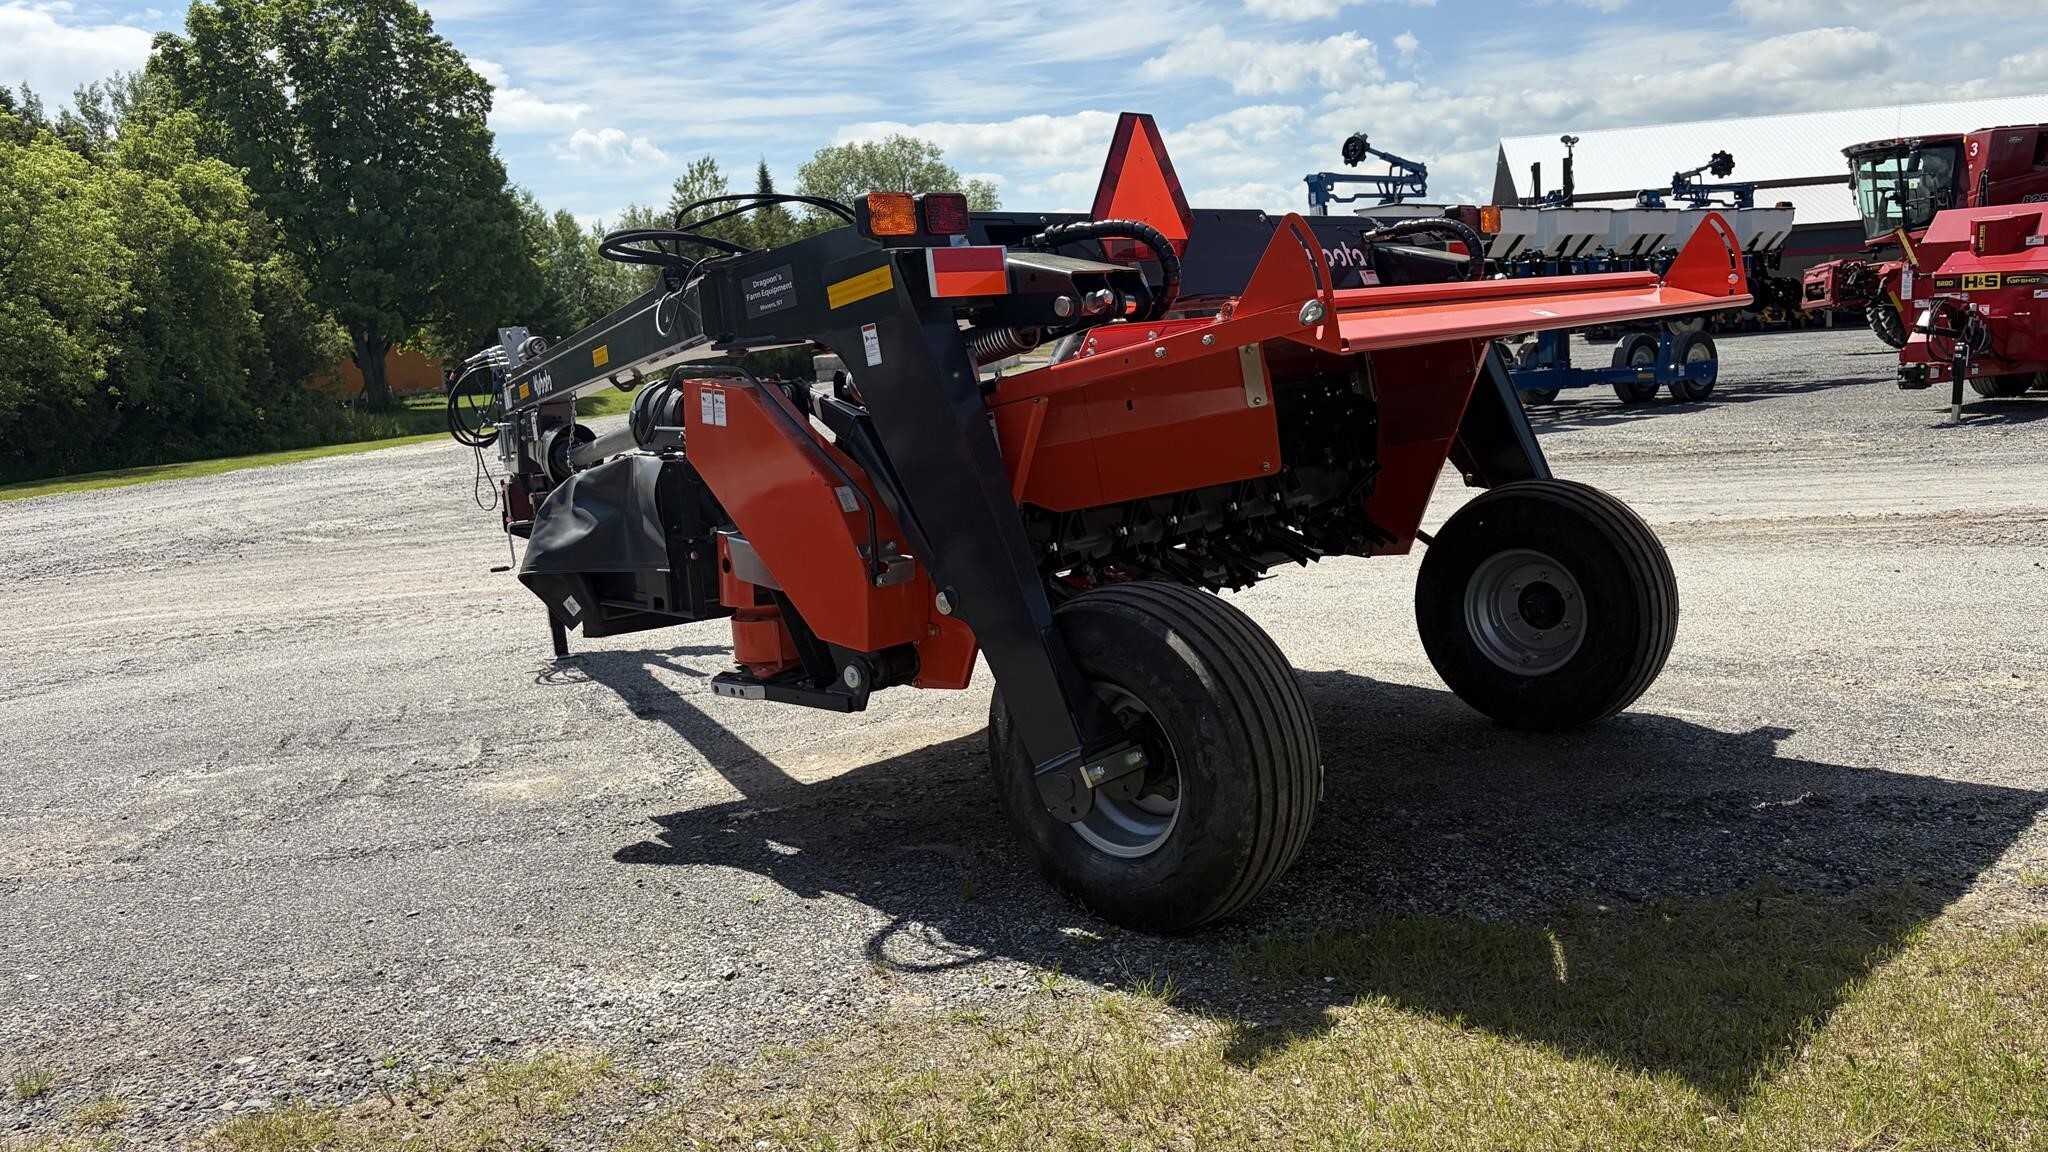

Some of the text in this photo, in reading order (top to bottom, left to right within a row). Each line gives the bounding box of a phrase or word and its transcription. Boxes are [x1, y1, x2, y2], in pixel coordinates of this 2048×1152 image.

[1970, 142, 1979, 157] 3
[752, 273, 782, 288] Dragoon's
[1964, 275, 1998, 289] H&S
[746, 281, 792, 302] Farm Equipment
